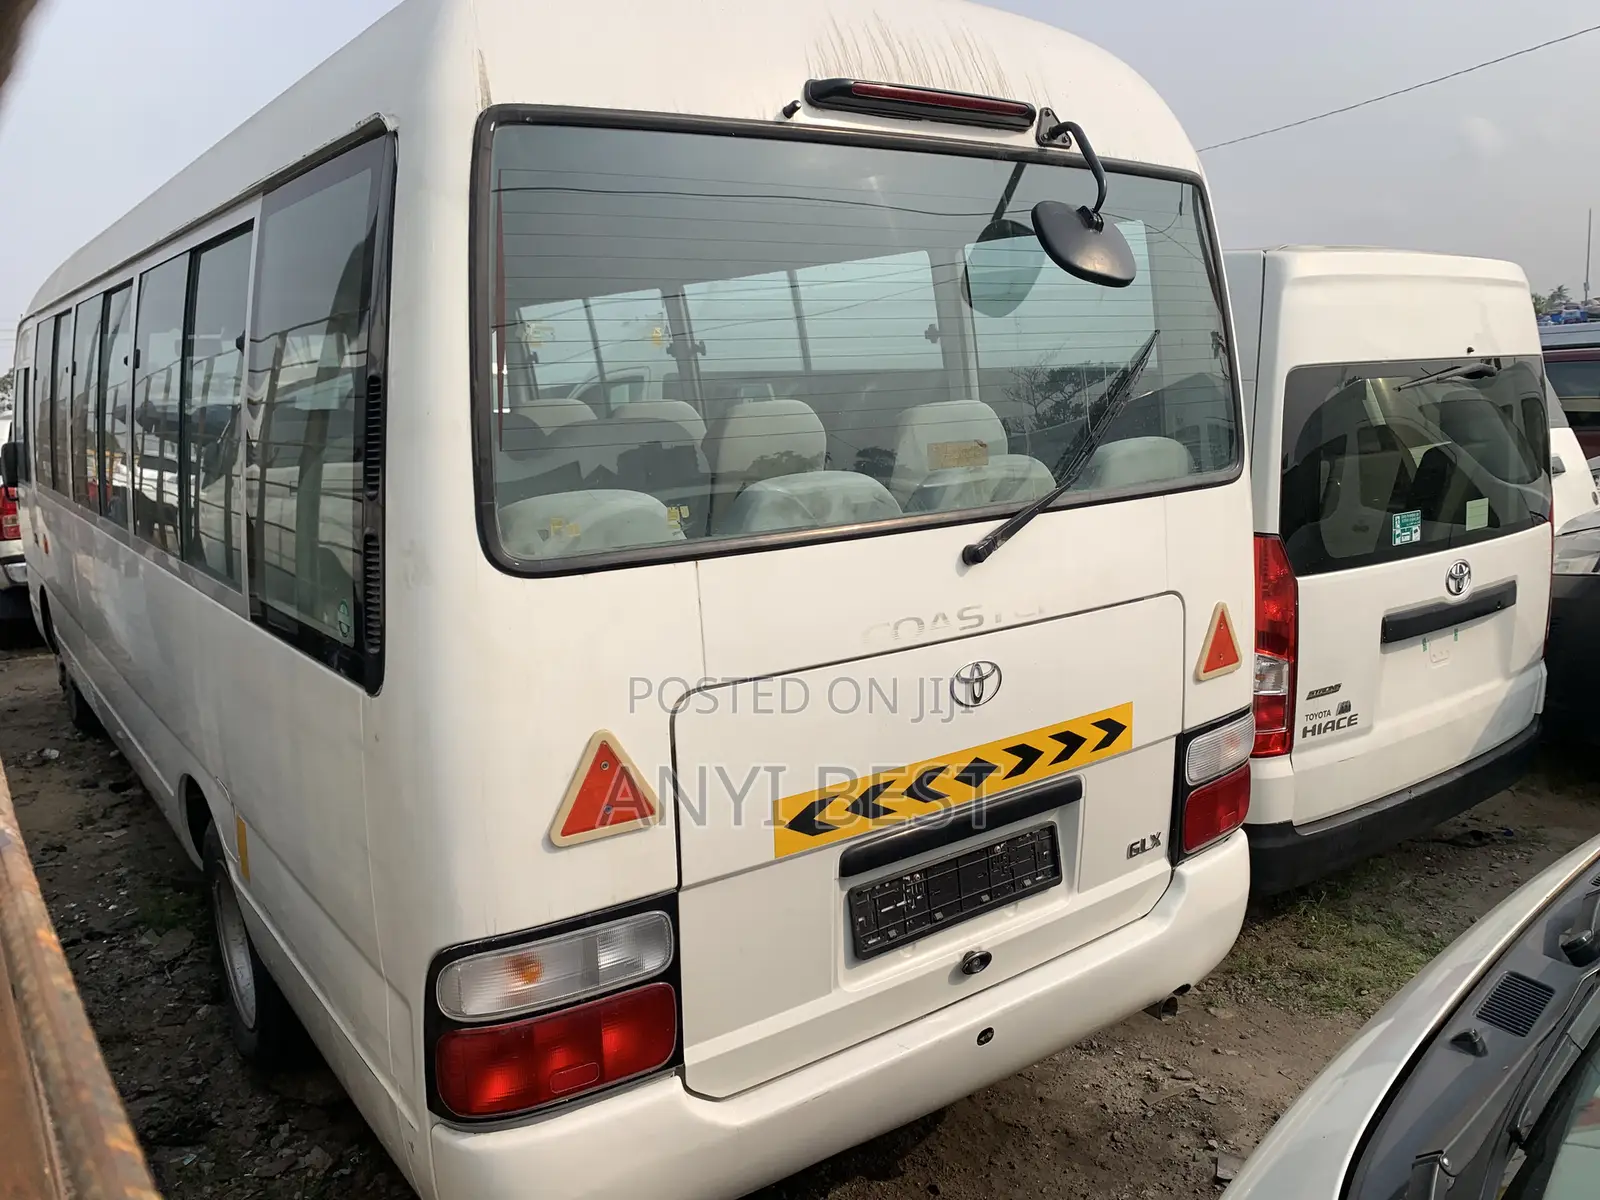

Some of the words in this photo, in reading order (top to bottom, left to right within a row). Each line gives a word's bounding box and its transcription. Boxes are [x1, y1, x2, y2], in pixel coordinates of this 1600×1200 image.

[1302, 713, 1359, 739] HIACE
[1305, 709, 1331, 722] TOYOTA
[1127, 831, 1161, 860] GLX
